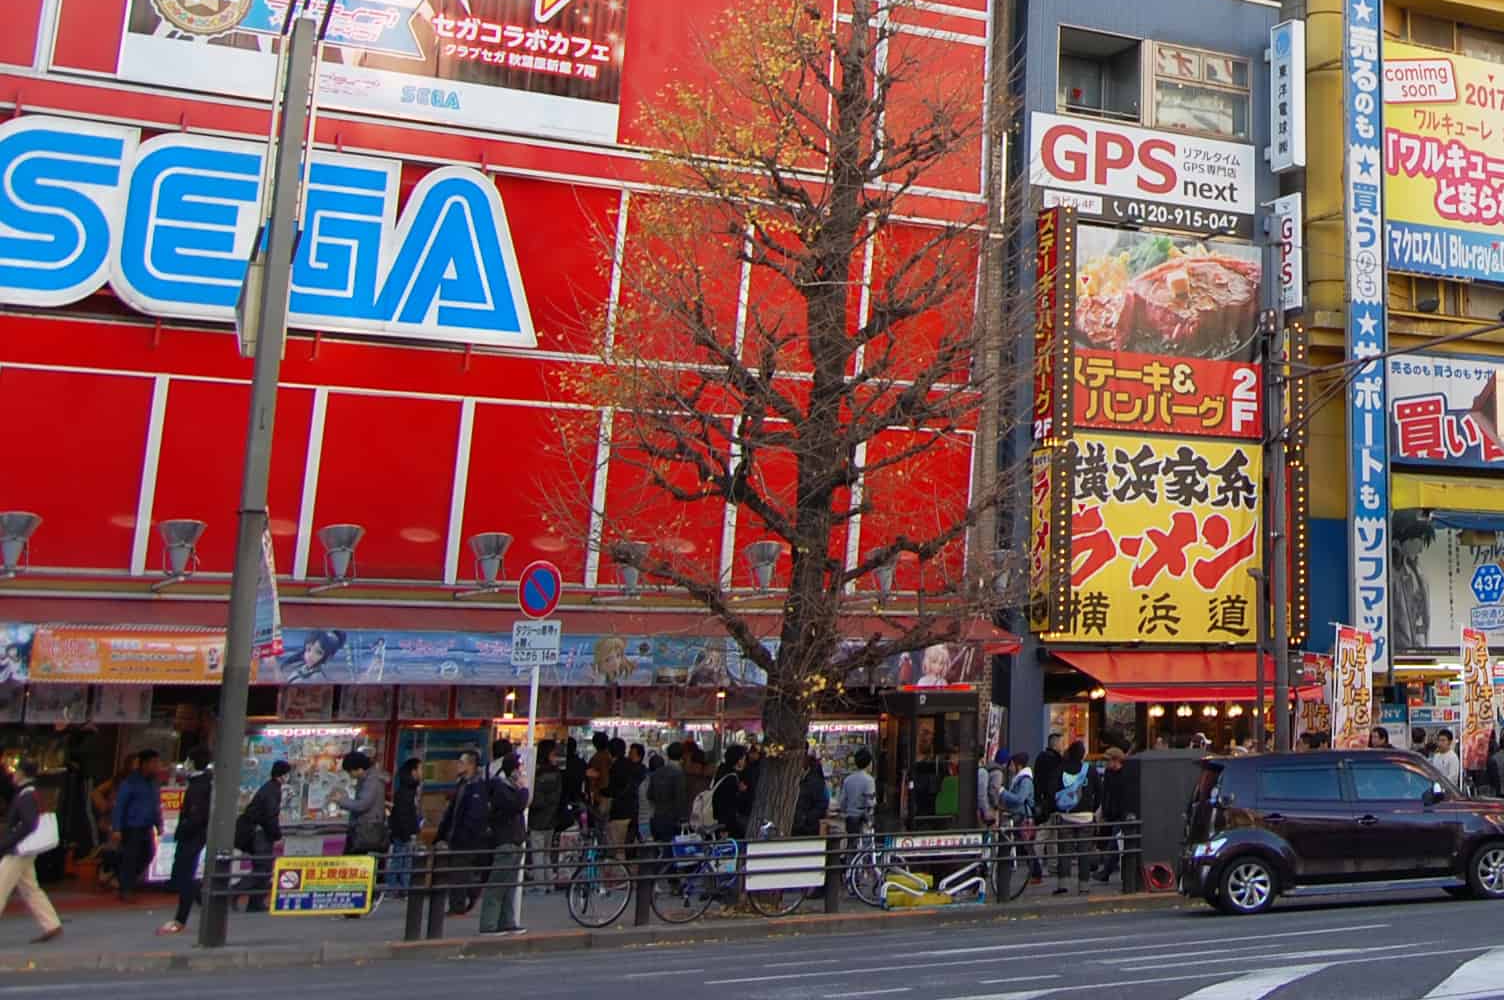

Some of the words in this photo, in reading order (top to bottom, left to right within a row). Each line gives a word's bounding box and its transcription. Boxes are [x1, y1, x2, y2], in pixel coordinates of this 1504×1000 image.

[431, 12, 611, 63] セガコラボカフェ
[400, 85, 461, 111] SEGA
[1350, 26, 1379, 139] 売るのも
[1401, 83, 1438, 99] soon
[1413, 109, 1494, 142] ワルキューレ
[1041, 124, 1178, 195] GPS
[1183, 148, 1241, 167] リアルタイム
[1183, 179, 1239, 203] next
[0, 115, 537, 348] SEGA
[1128, 202, 1238, 230] 0120-915-047
[1280, 217, 1294, 285] GPS
[1351, 182, 1380, 298] 買うのも
[1391, 360, 1431, 377] 売るのも
[1433, 363, 1473, 380] 買うのも
[1034, 418, 1052, 441] 2F
[1086, 392, 1227, 428] ハンバーグ
[1354, 343, 1383, 509] サポートも
[1068, 440, 1258, 511] 横浜家系
[1071, 504, 1259, 592] ラーメン
[1355, 526, 1386, 663] ソフマップ
[1473, 573, 1503, 593] 437
[1068, 591, 1251, 637] 横浜道
